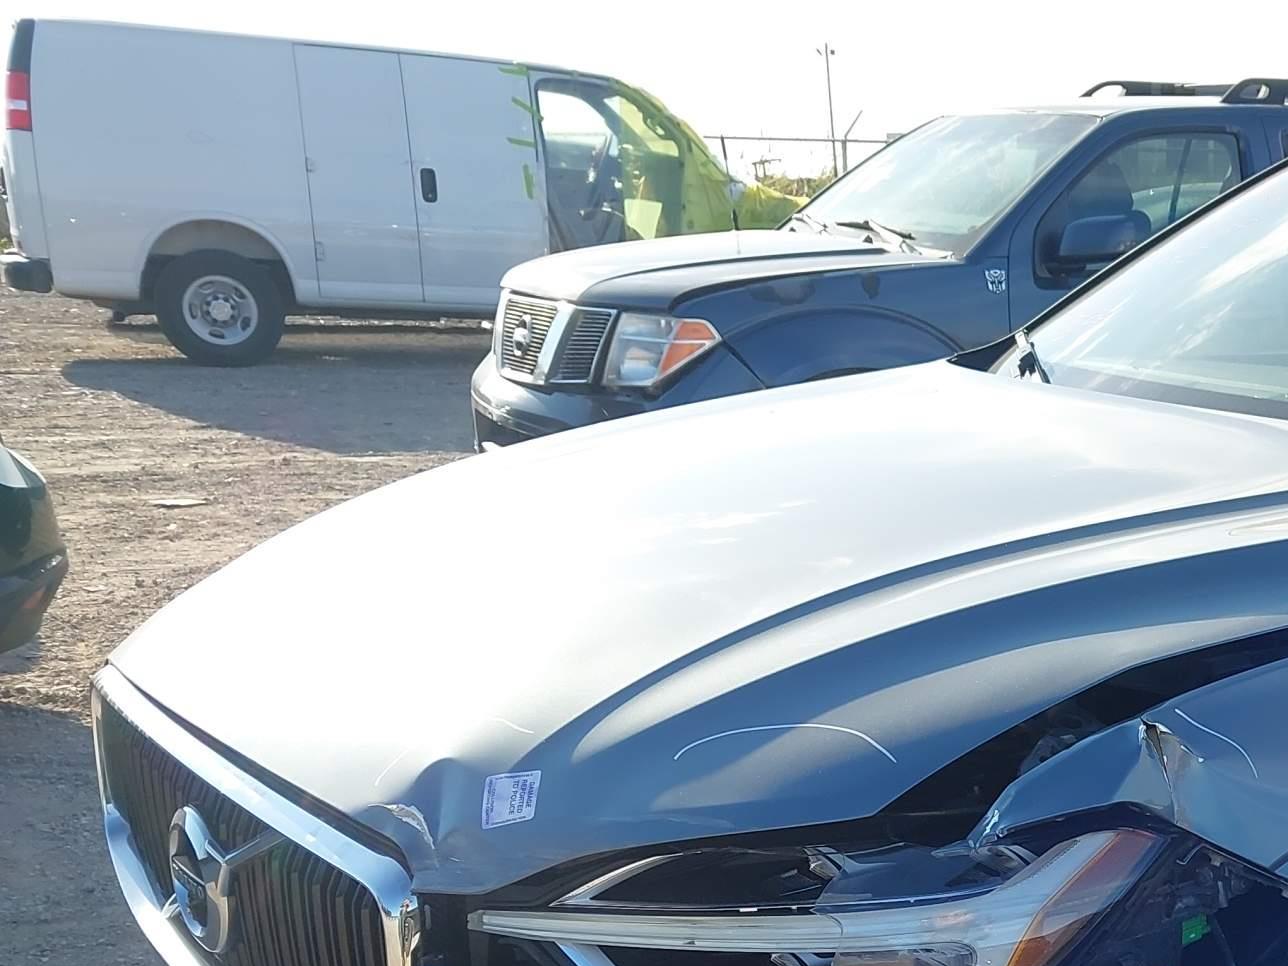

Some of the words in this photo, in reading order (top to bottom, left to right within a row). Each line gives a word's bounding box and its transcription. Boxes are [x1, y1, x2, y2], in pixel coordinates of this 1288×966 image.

[508, 790, 518, 816] POLICE
[516, 779, 528, 814] REPORTED
[526, 781, 536, 809] DAMAGE
